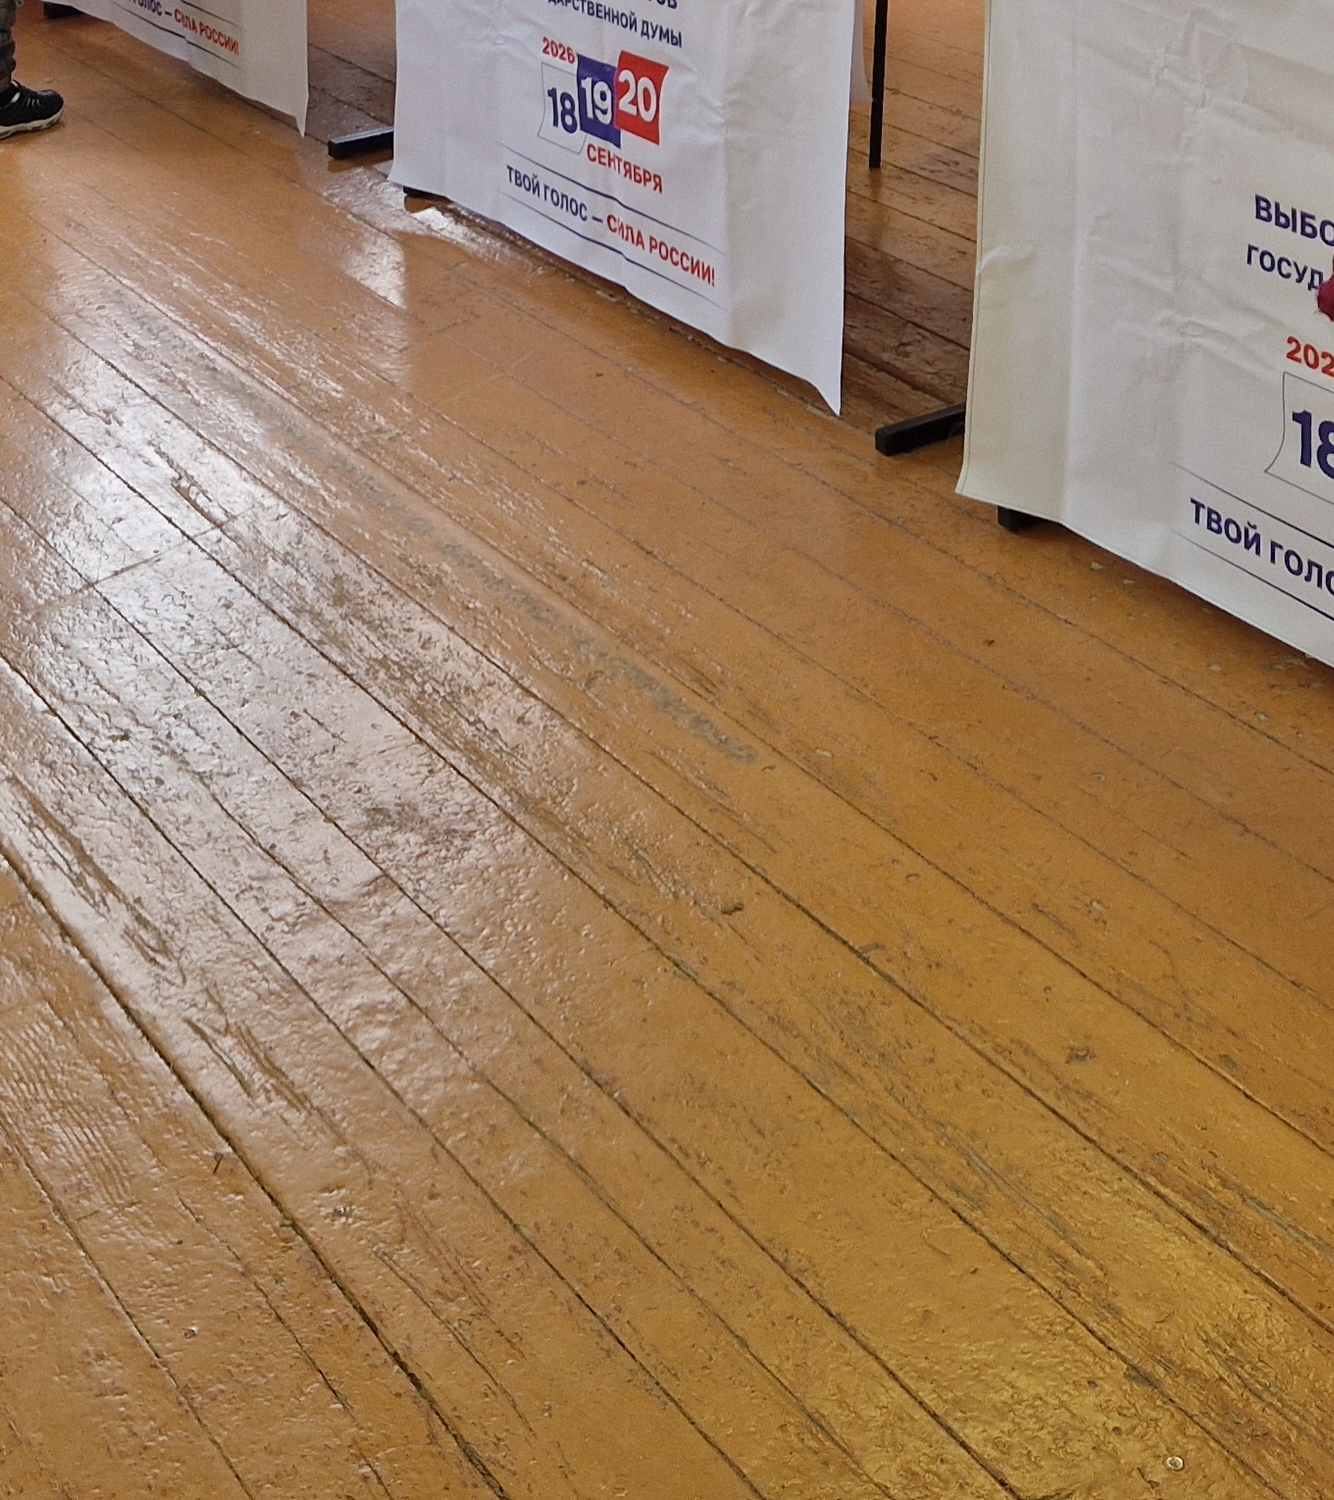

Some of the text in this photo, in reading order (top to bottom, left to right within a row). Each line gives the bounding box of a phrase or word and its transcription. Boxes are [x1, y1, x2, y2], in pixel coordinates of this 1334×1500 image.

[199, 24, 239, 56] РОССИИ!
[541, 36, 576, 65] 2026
[641, 19, 683, 49] ДУМЫ
[547, 69, 657, 134] 18 19 20
[587, 143, 663, 194] СЕНТЯБРЯ
[506, 164, 540, 199] ТВОЙ
[543, 184, 588, 222] ГОЛОС
[606, 213, 645, 250] СИЛА
[649, 235, 715, 287] РОССИИ!
[1190, 497, 1261, 557] ТВОЙ
